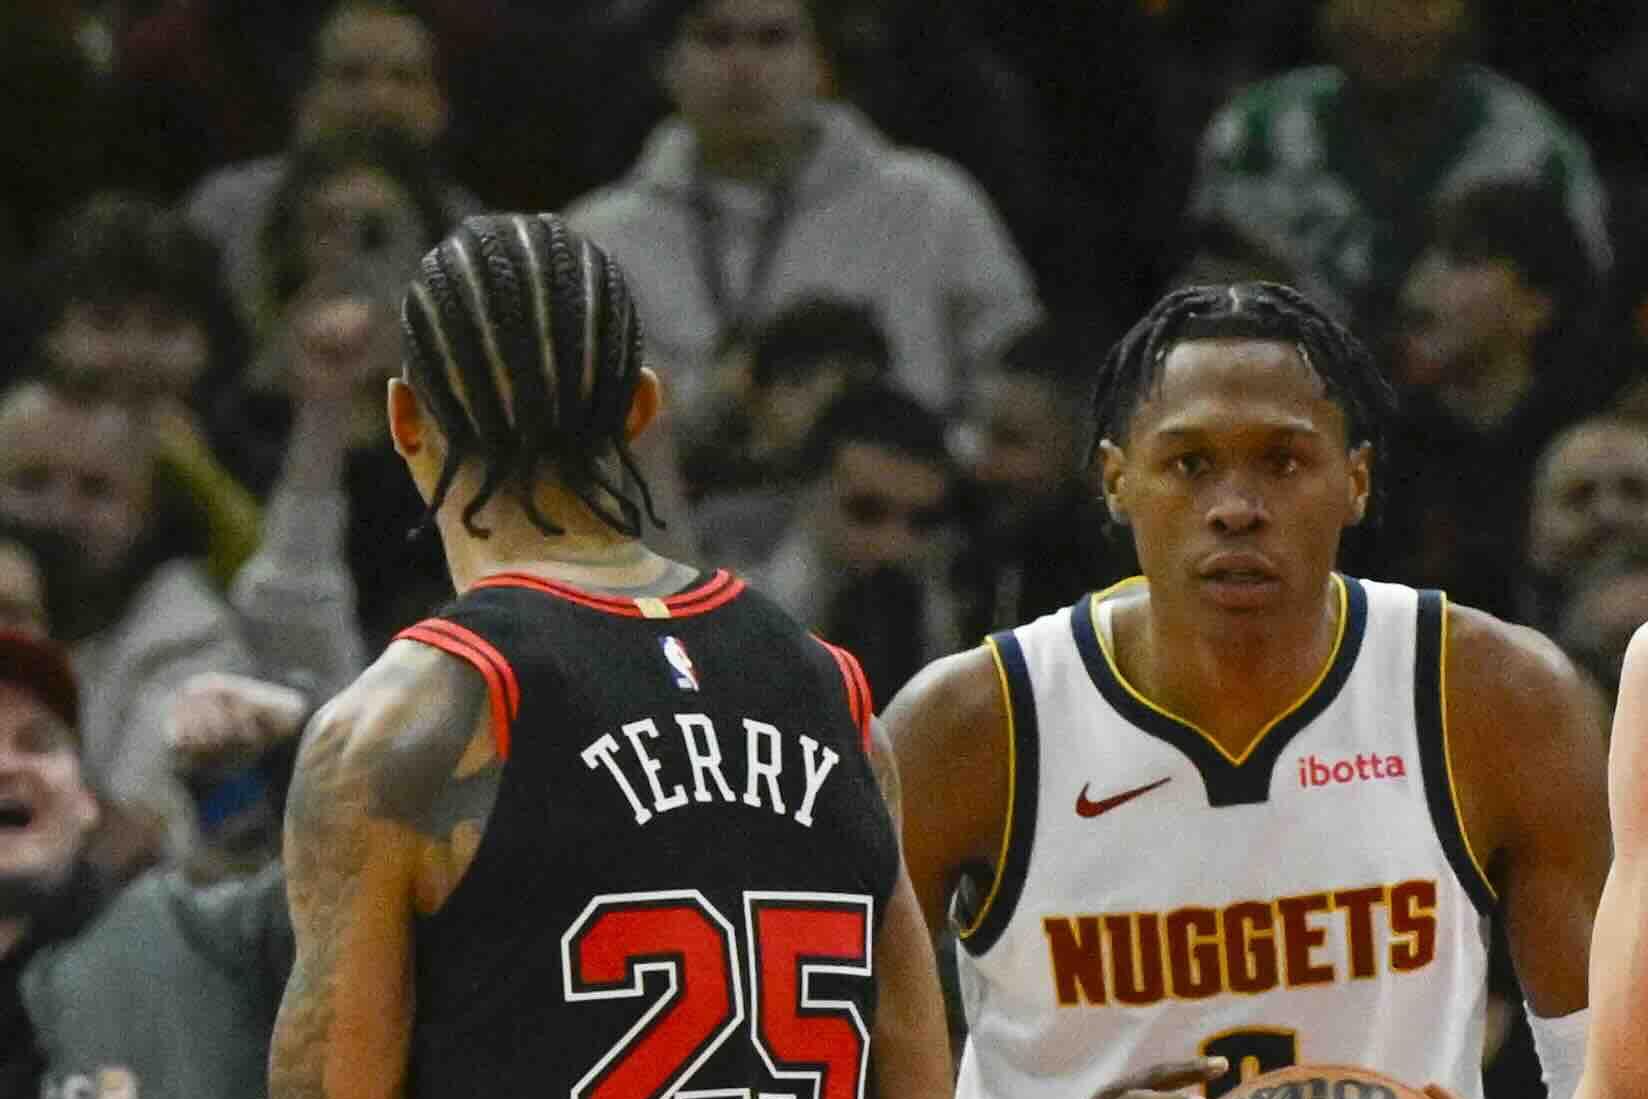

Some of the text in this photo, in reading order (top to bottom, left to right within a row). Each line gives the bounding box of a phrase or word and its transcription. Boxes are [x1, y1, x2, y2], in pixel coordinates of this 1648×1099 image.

[580, 713, 840, 828] TERRY
[1297, 752, 1406, 788] ibotta
[1040, 879, 1438, 1008] NUGGETS
